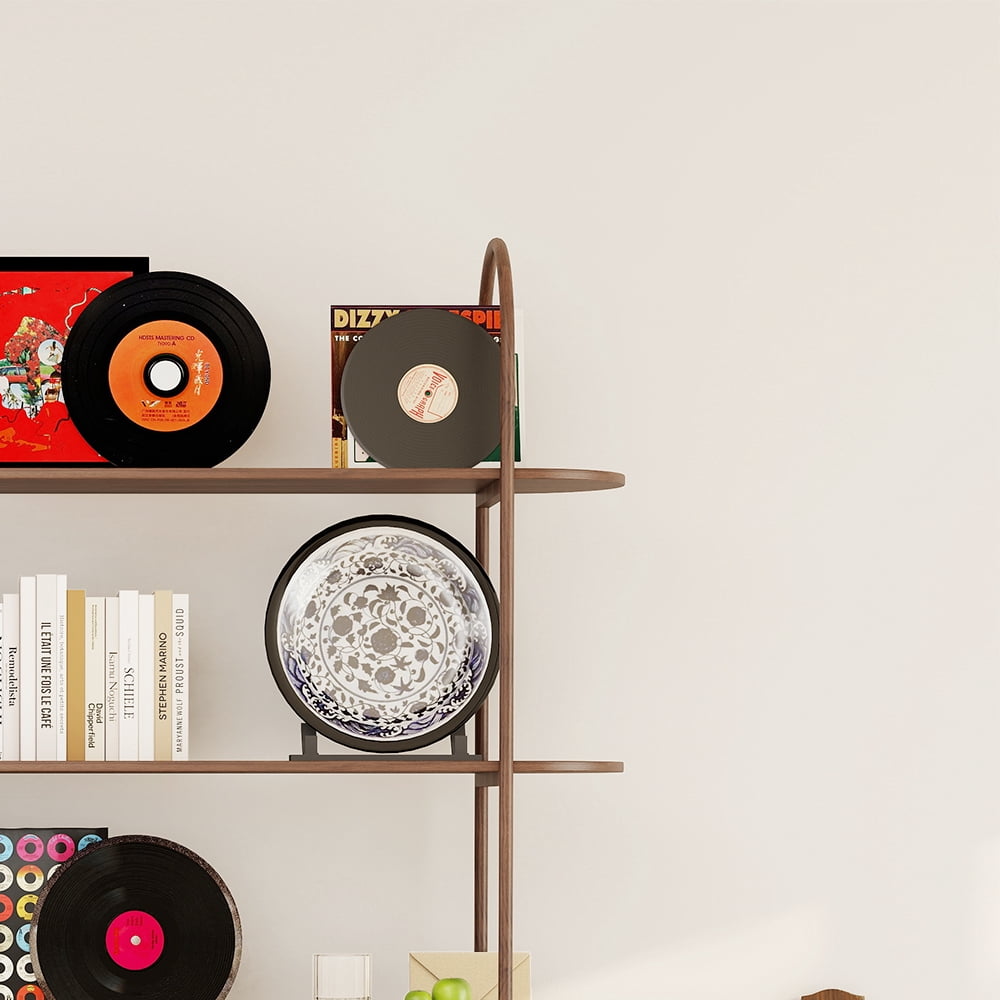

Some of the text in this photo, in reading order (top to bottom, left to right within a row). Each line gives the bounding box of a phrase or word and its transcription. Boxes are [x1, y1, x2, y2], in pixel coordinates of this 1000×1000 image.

[175, 608, 184, 637] SQUID
[8, 646, 18, 707] Remodelista
[41, 622, 53, 728] IL ÉTAIT UNE FOIS LE CAFÉ
[107, 652, 118, 722] Isamu Noguchi
[124, 667, 134, 720] SCHIELE
[158, 632, 167, 720] STEPHEN MARINO
[176, 658, 184, 694] PROUST
[88, 702, 96, 748] Chipperfield
[96, 702, 104, 724] David
